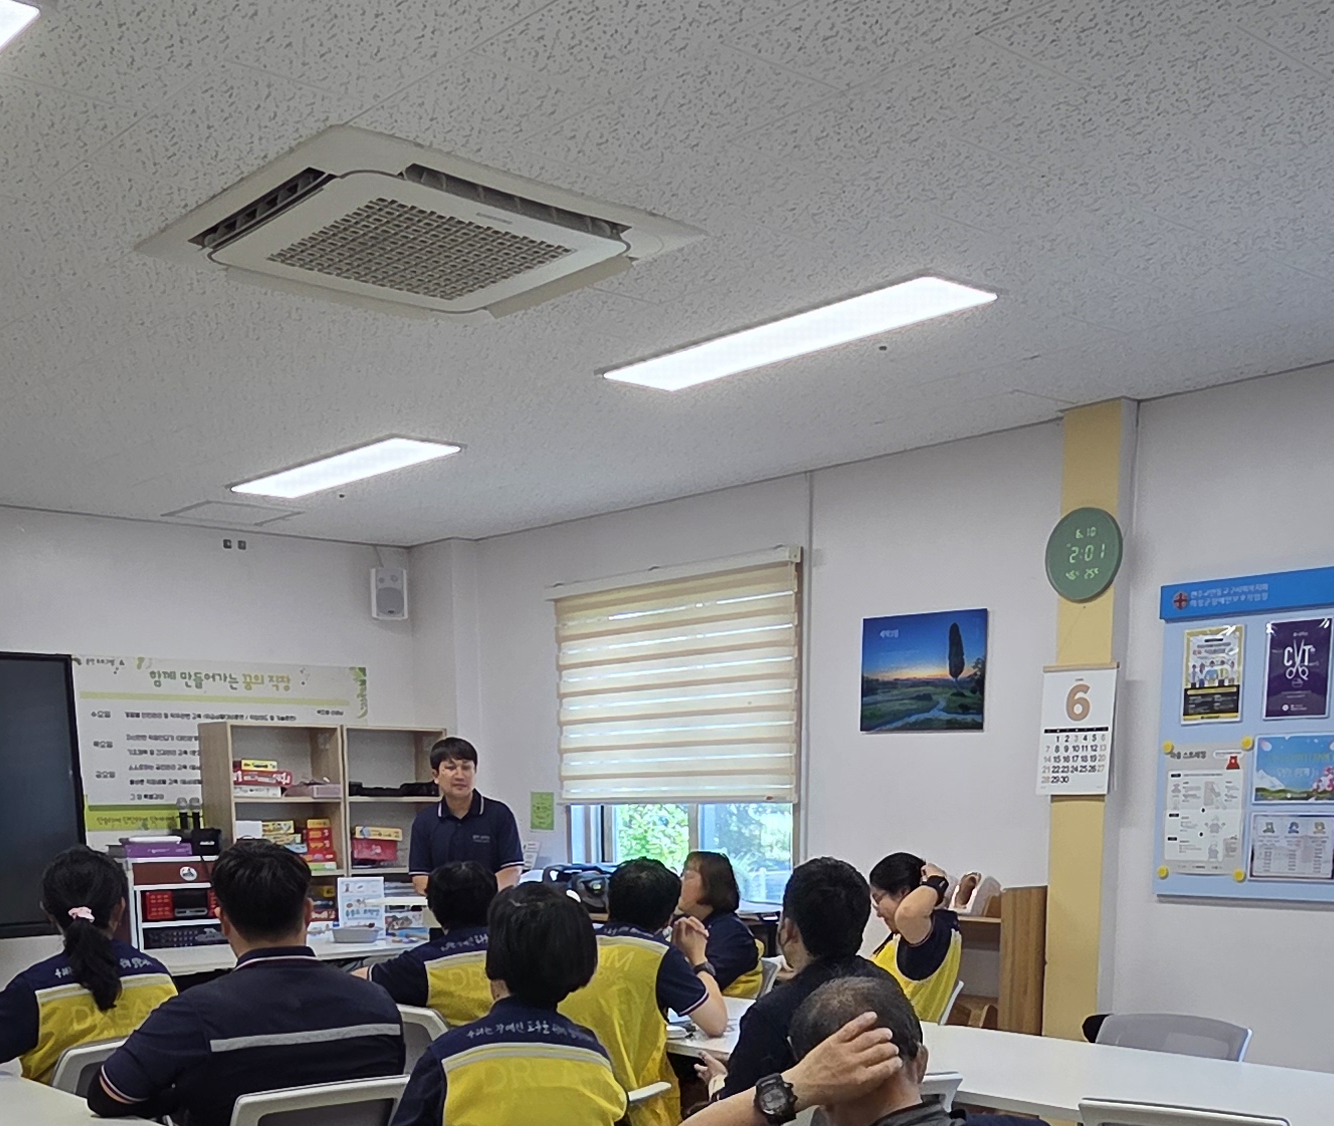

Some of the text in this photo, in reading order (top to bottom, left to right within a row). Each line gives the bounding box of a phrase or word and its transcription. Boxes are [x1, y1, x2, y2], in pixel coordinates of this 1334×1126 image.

[1069, 544, 1105, 563] 2:01
[149, 670, 290, 692] 함께 만들어가는 꿈의 직장
[1067, 683, 1091, 722] 6
